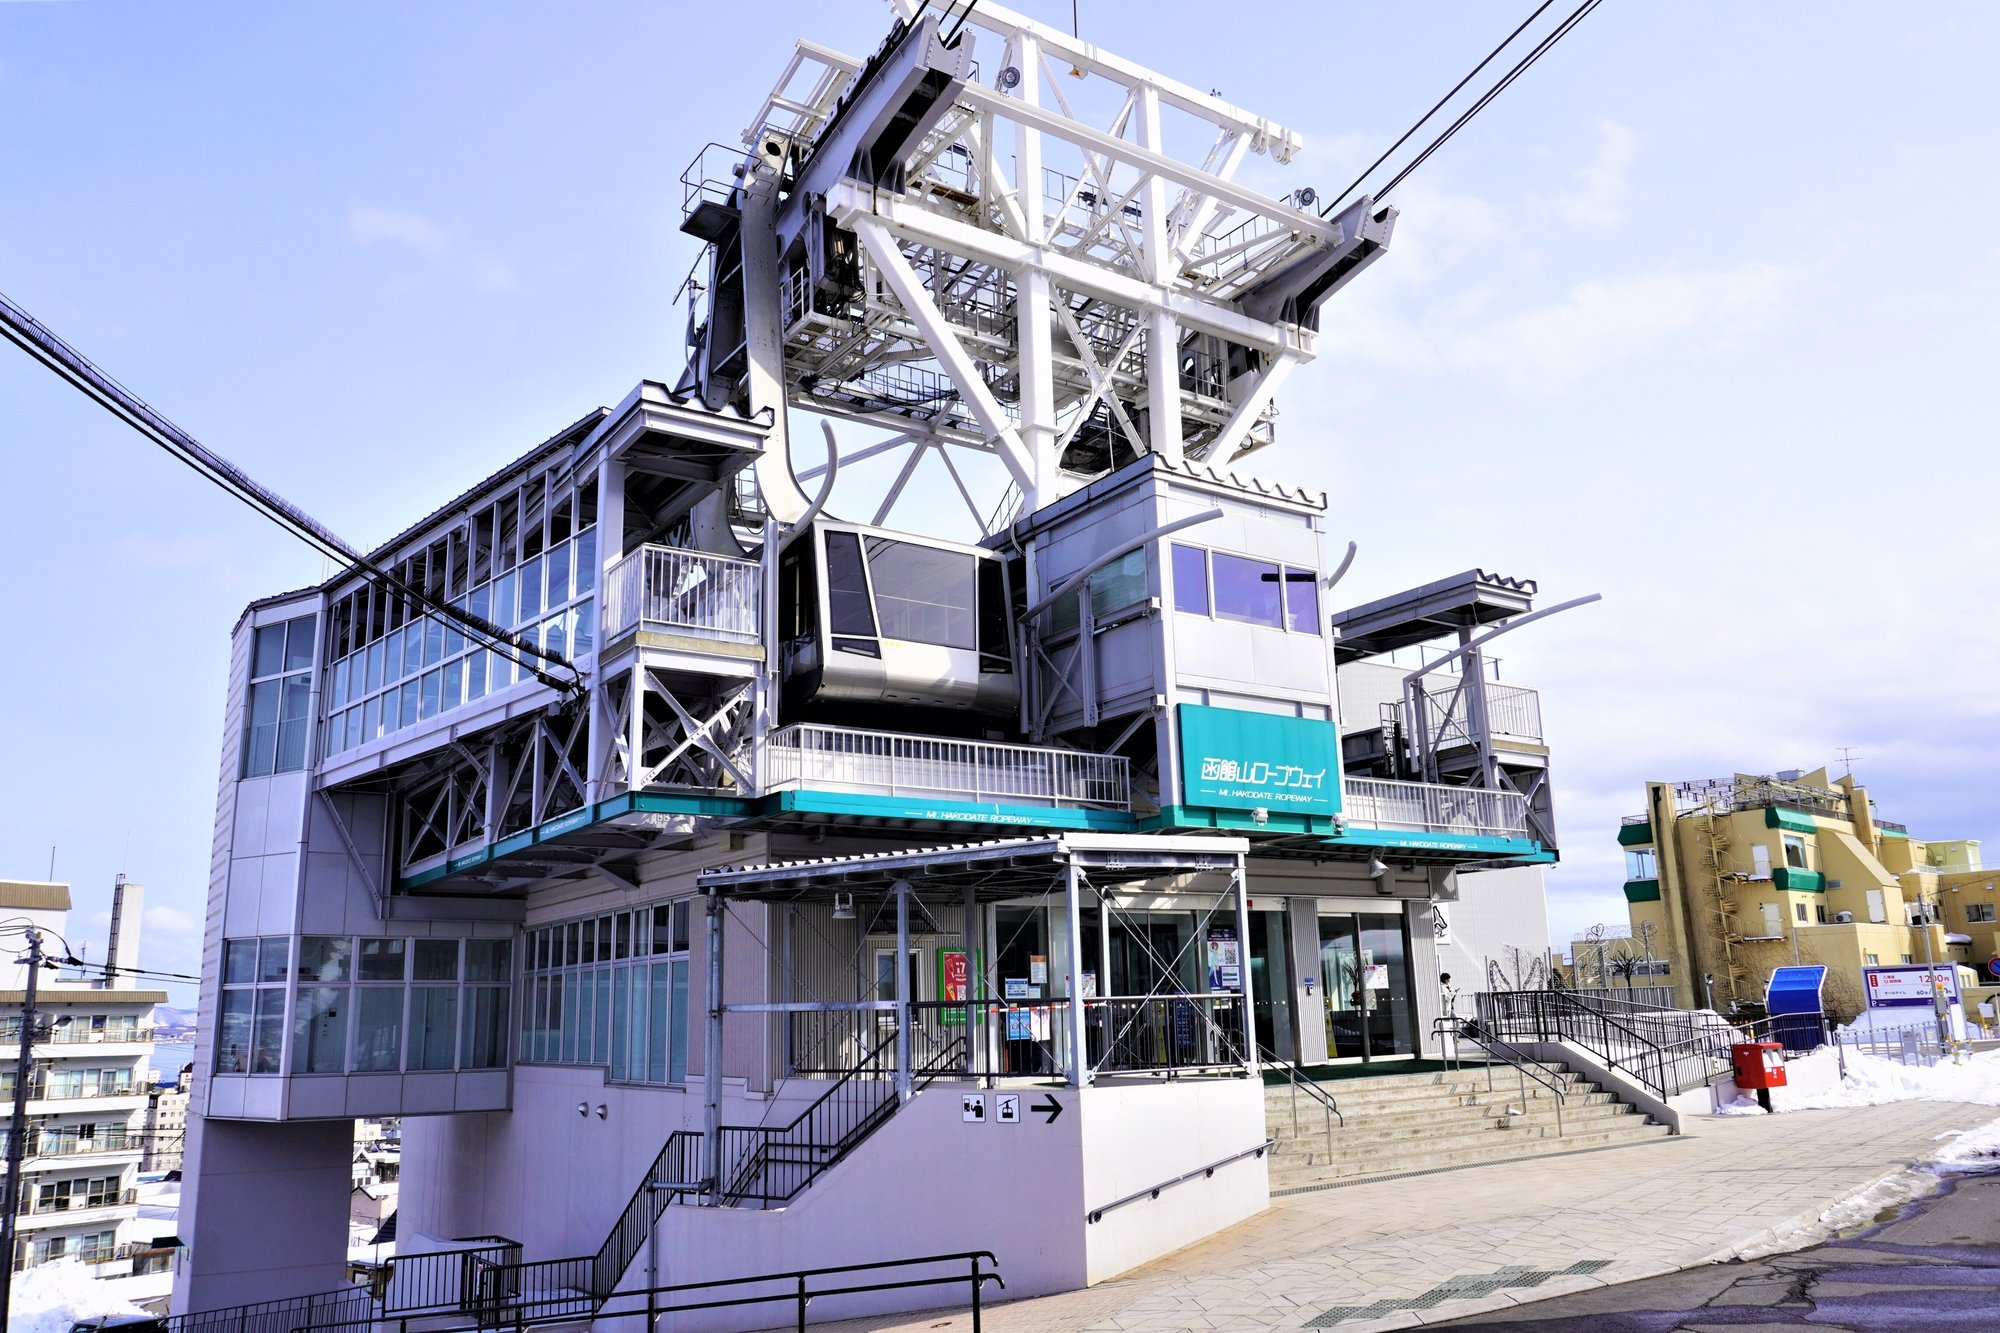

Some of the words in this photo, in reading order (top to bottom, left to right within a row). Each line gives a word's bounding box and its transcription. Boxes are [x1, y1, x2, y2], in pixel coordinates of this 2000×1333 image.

[1201, 757, 1326, 789] 函館山ロープウェイ
[1218, 788, 1231, 797] Mt.
[1231, 791, 1274, 800] HAKODATE
[1275, 793, 1312, 803] ROPEWAY
[941, 812, 988, 822] HAKODATE
[990, 815, 1033, 824] ROPEWAY
[1409, 841, 1439, 849] HAKODATE
